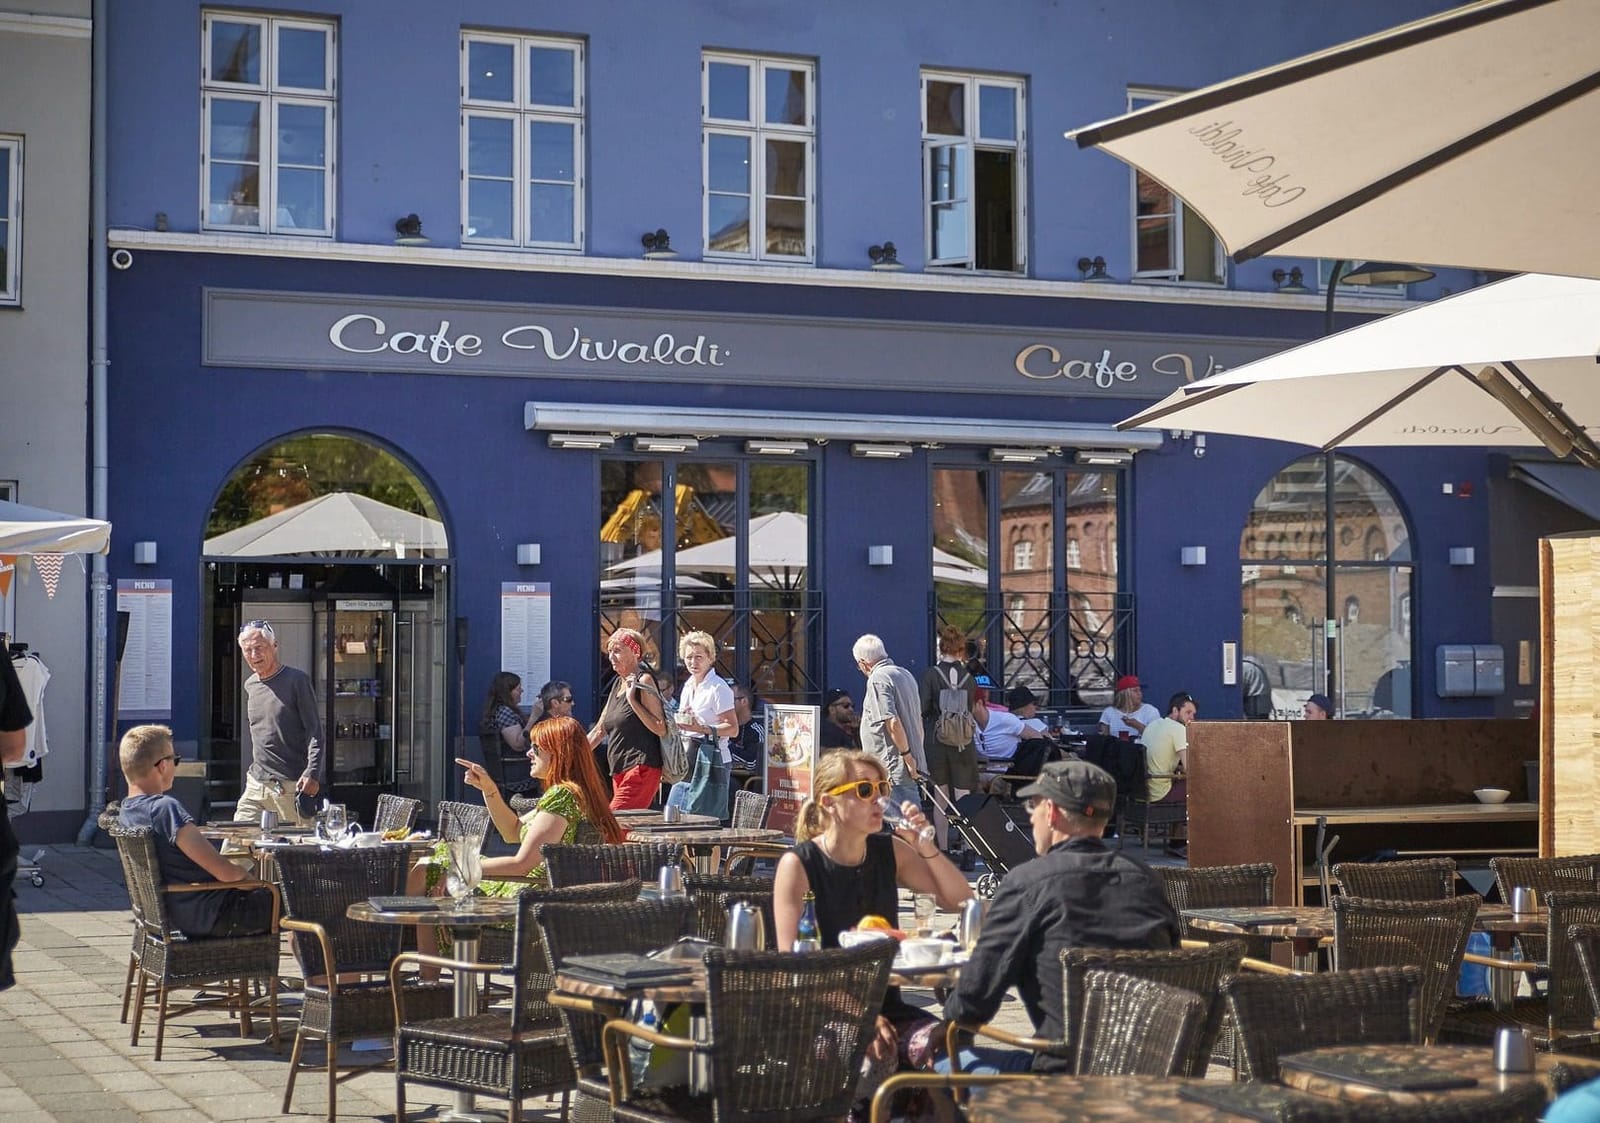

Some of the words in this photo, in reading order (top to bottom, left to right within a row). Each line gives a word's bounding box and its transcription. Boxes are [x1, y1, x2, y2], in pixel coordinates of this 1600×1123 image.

[329, 313, 483, 365] Cafe
[502, 325, 725, 366] Vivaldi
[1015, 344, 1138, 389] Cafe
[134, 581, 155, 589] MENU
